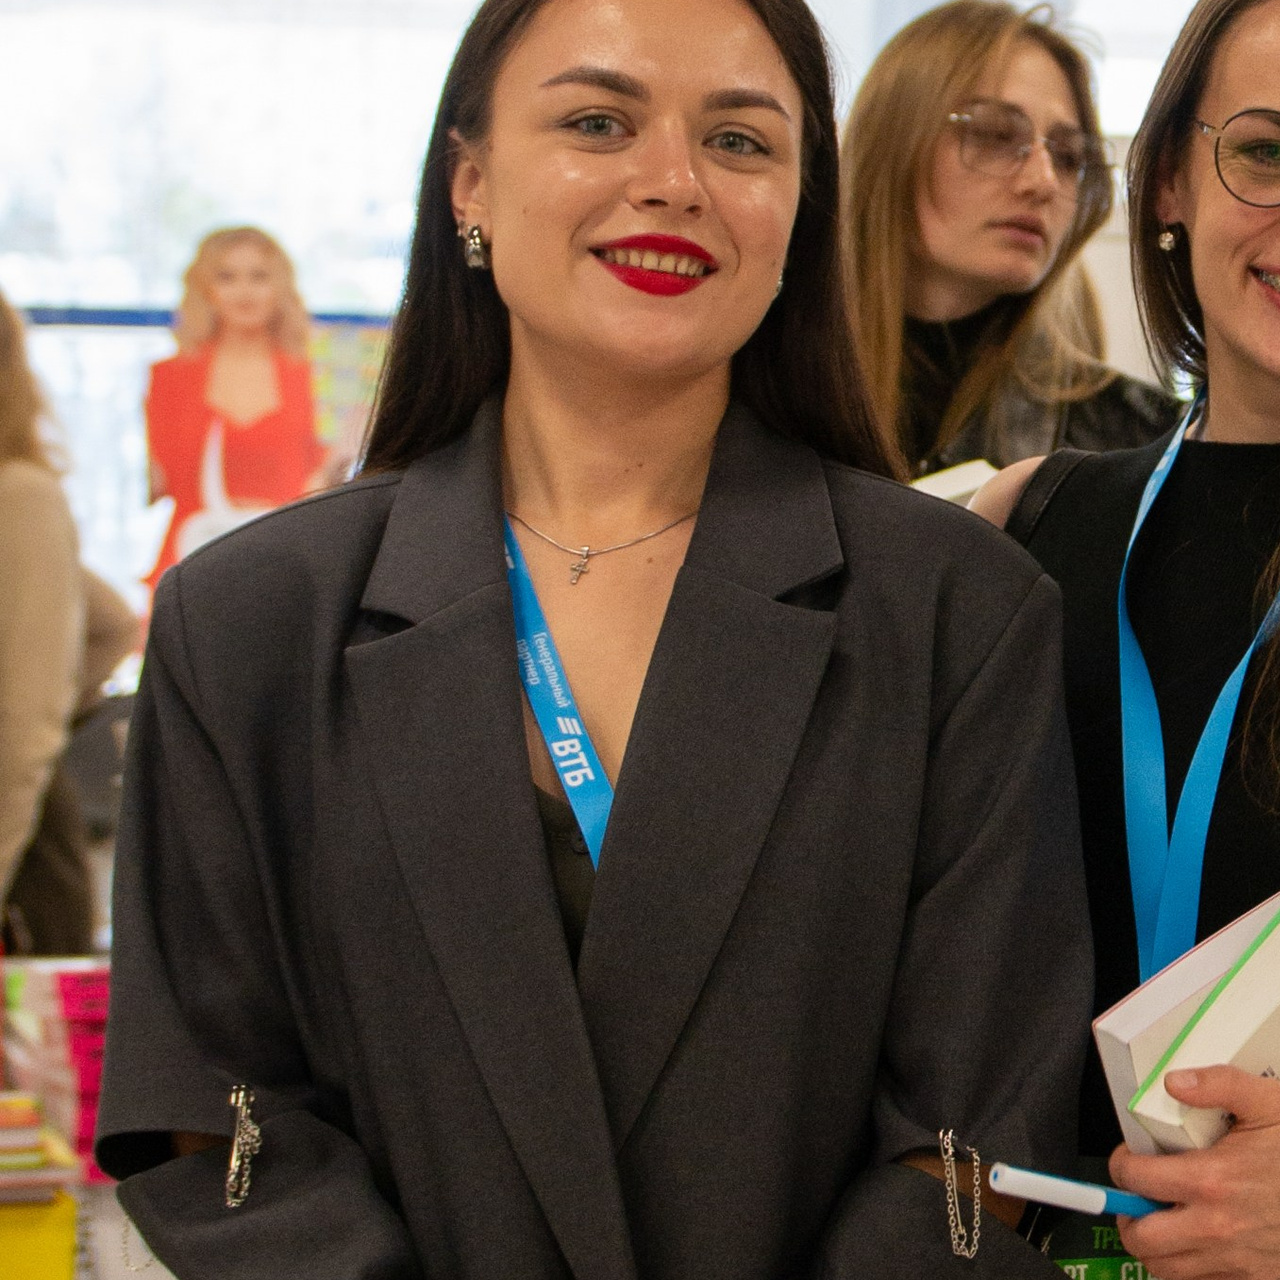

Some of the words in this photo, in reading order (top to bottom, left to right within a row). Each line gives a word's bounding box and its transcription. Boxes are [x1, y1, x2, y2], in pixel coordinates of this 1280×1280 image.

[517, 639, 540, 685] партнер
[533, 631, 571, 708] Генеральный
[551, 736, 595, 788] ВТБ
[1091, 1226, 1122, 1250] ТРЕ
